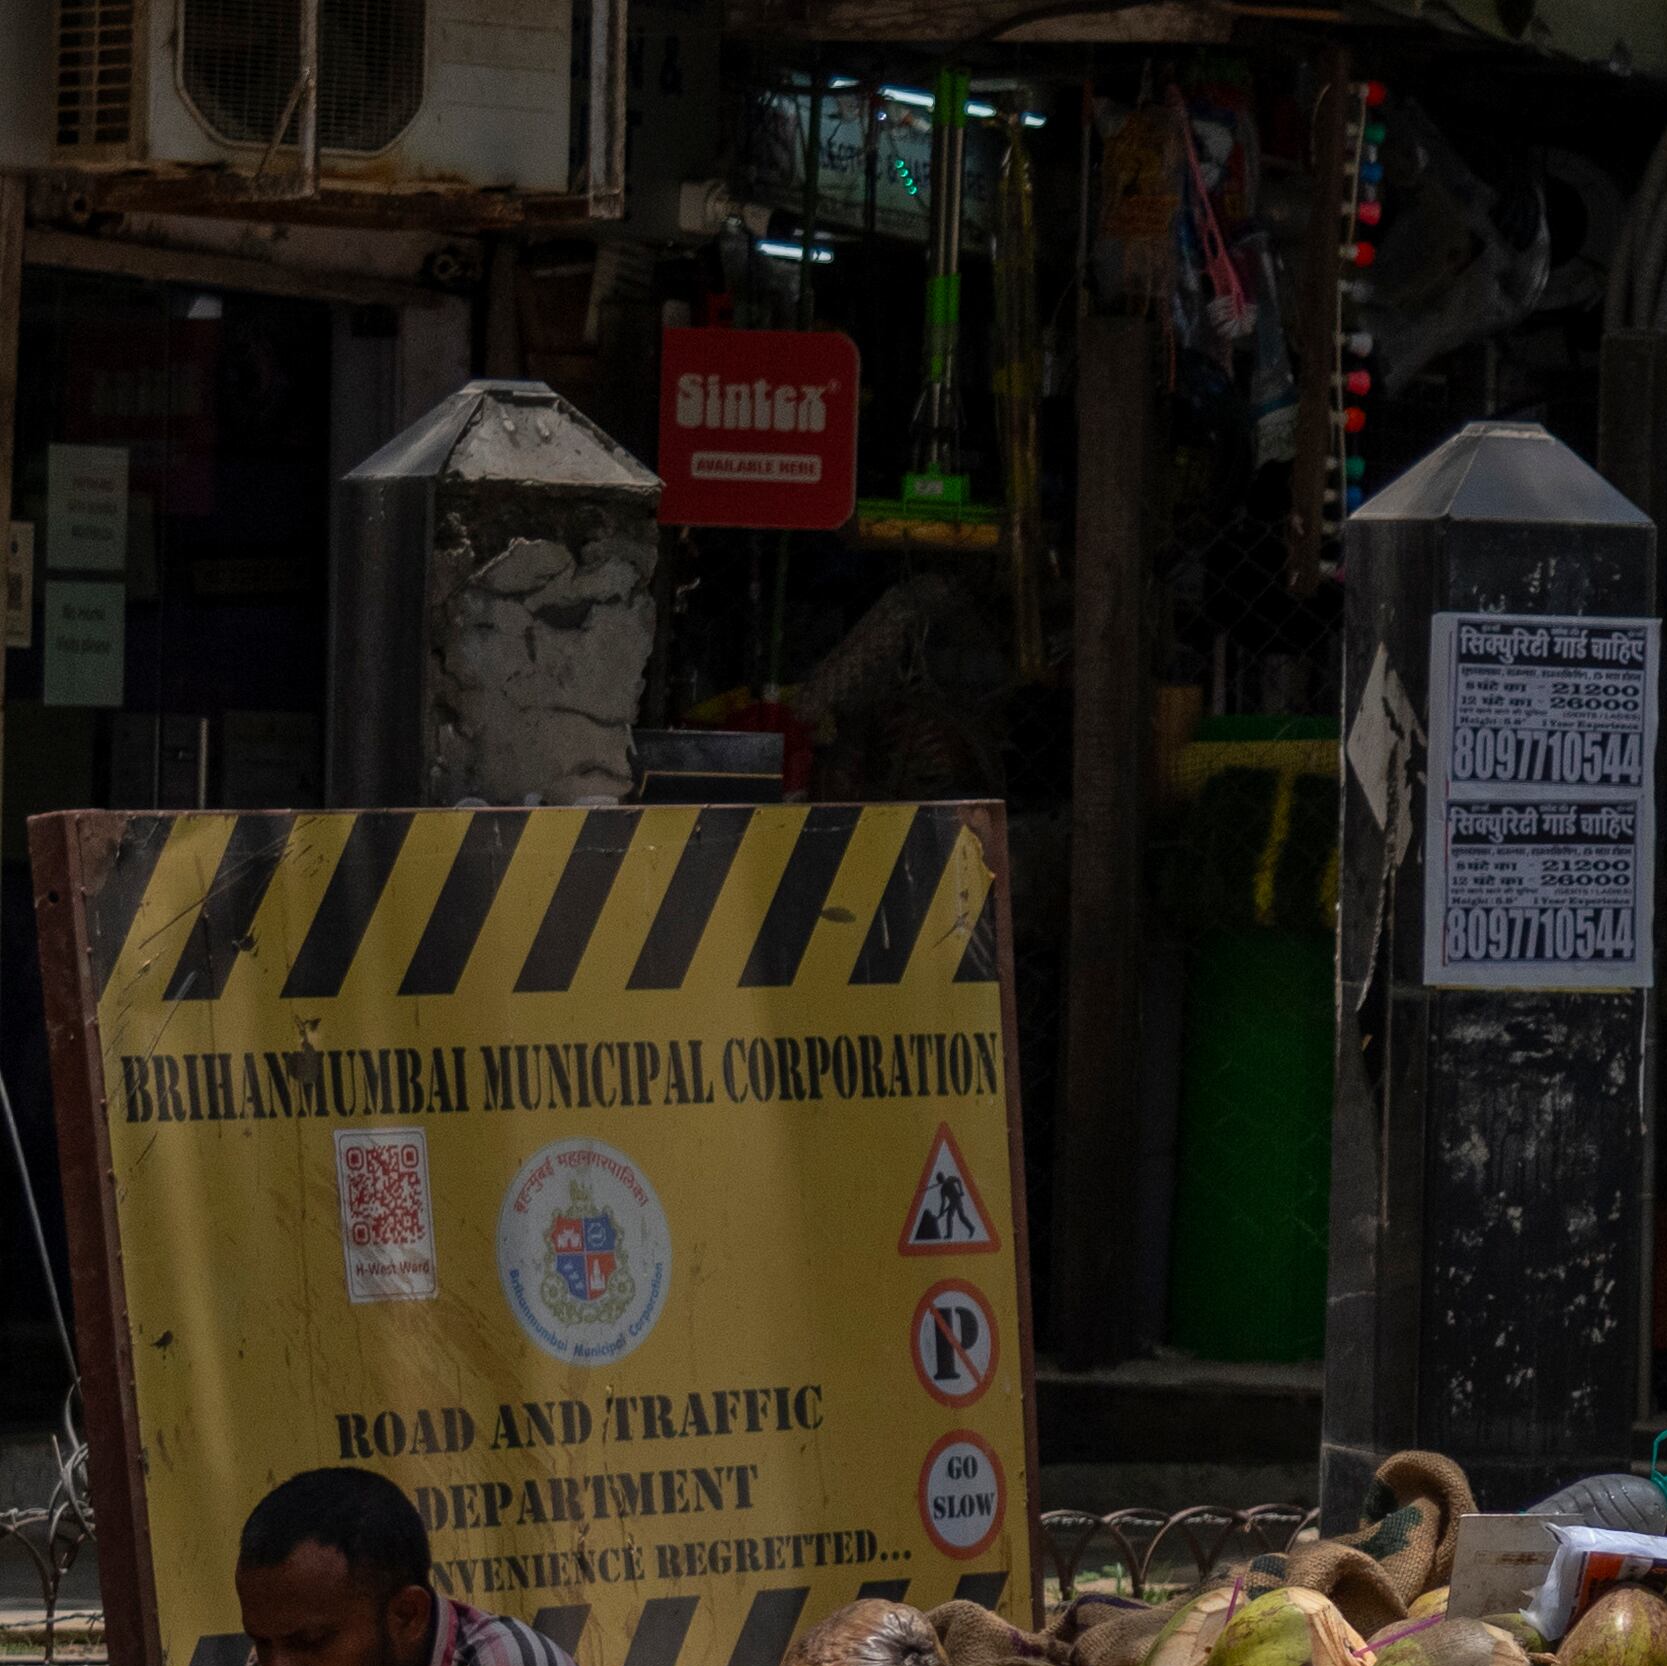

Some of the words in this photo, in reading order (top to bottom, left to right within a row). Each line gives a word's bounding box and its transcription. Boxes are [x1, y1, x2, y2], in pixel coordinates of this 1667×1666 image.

[676, 372, 827, 432] Sintex
[697, 459, 772, 473] AVAILABLE
[779, 462, 815, 475] HERE
[1460, 625, 1550, 664] सिक्युरिटी
[1552, 629, 1588, 660] गार्ड
[1590, 631, 1645, 664] चाहिए
[1550, 697, 1639, 711] 26000
[1551, 682, 1640, 697] 21200
[1455, 727, 1642, 785] 8097710544
[1449, 806, 1539, 843] सिक्युरिटी
[1541, 805, 1578, 836] गार्ड
[1580, 807, 1635, 839] चाहिए
[1540, 874, 1630, 886] 26000
[1542, 860, 1630, 872] 21200
[1448, 907, 1634, 961] 8097710544
[121, 1046, 470, 1122] BRIHANMUMBAI
[480, 1040, 714, 1110] MUNICIPAL
[723, 1032, 998, 1103] CORPORATION
[336, 1407, 475, 1460] ROAD
[490, 1400, 593, 1450] AND
[611, 1384, 824, 1442] TRAFFIC
[947, 1454, 978, 1480] GO
[416, 1464, 758, 1533] DEPARTMENT
[933, 1493, 994, 1520] SLOW
[428, 1546, 645, 1594] NVENIENCE
[656, 1528, 912, 1580] REGRETTED...
